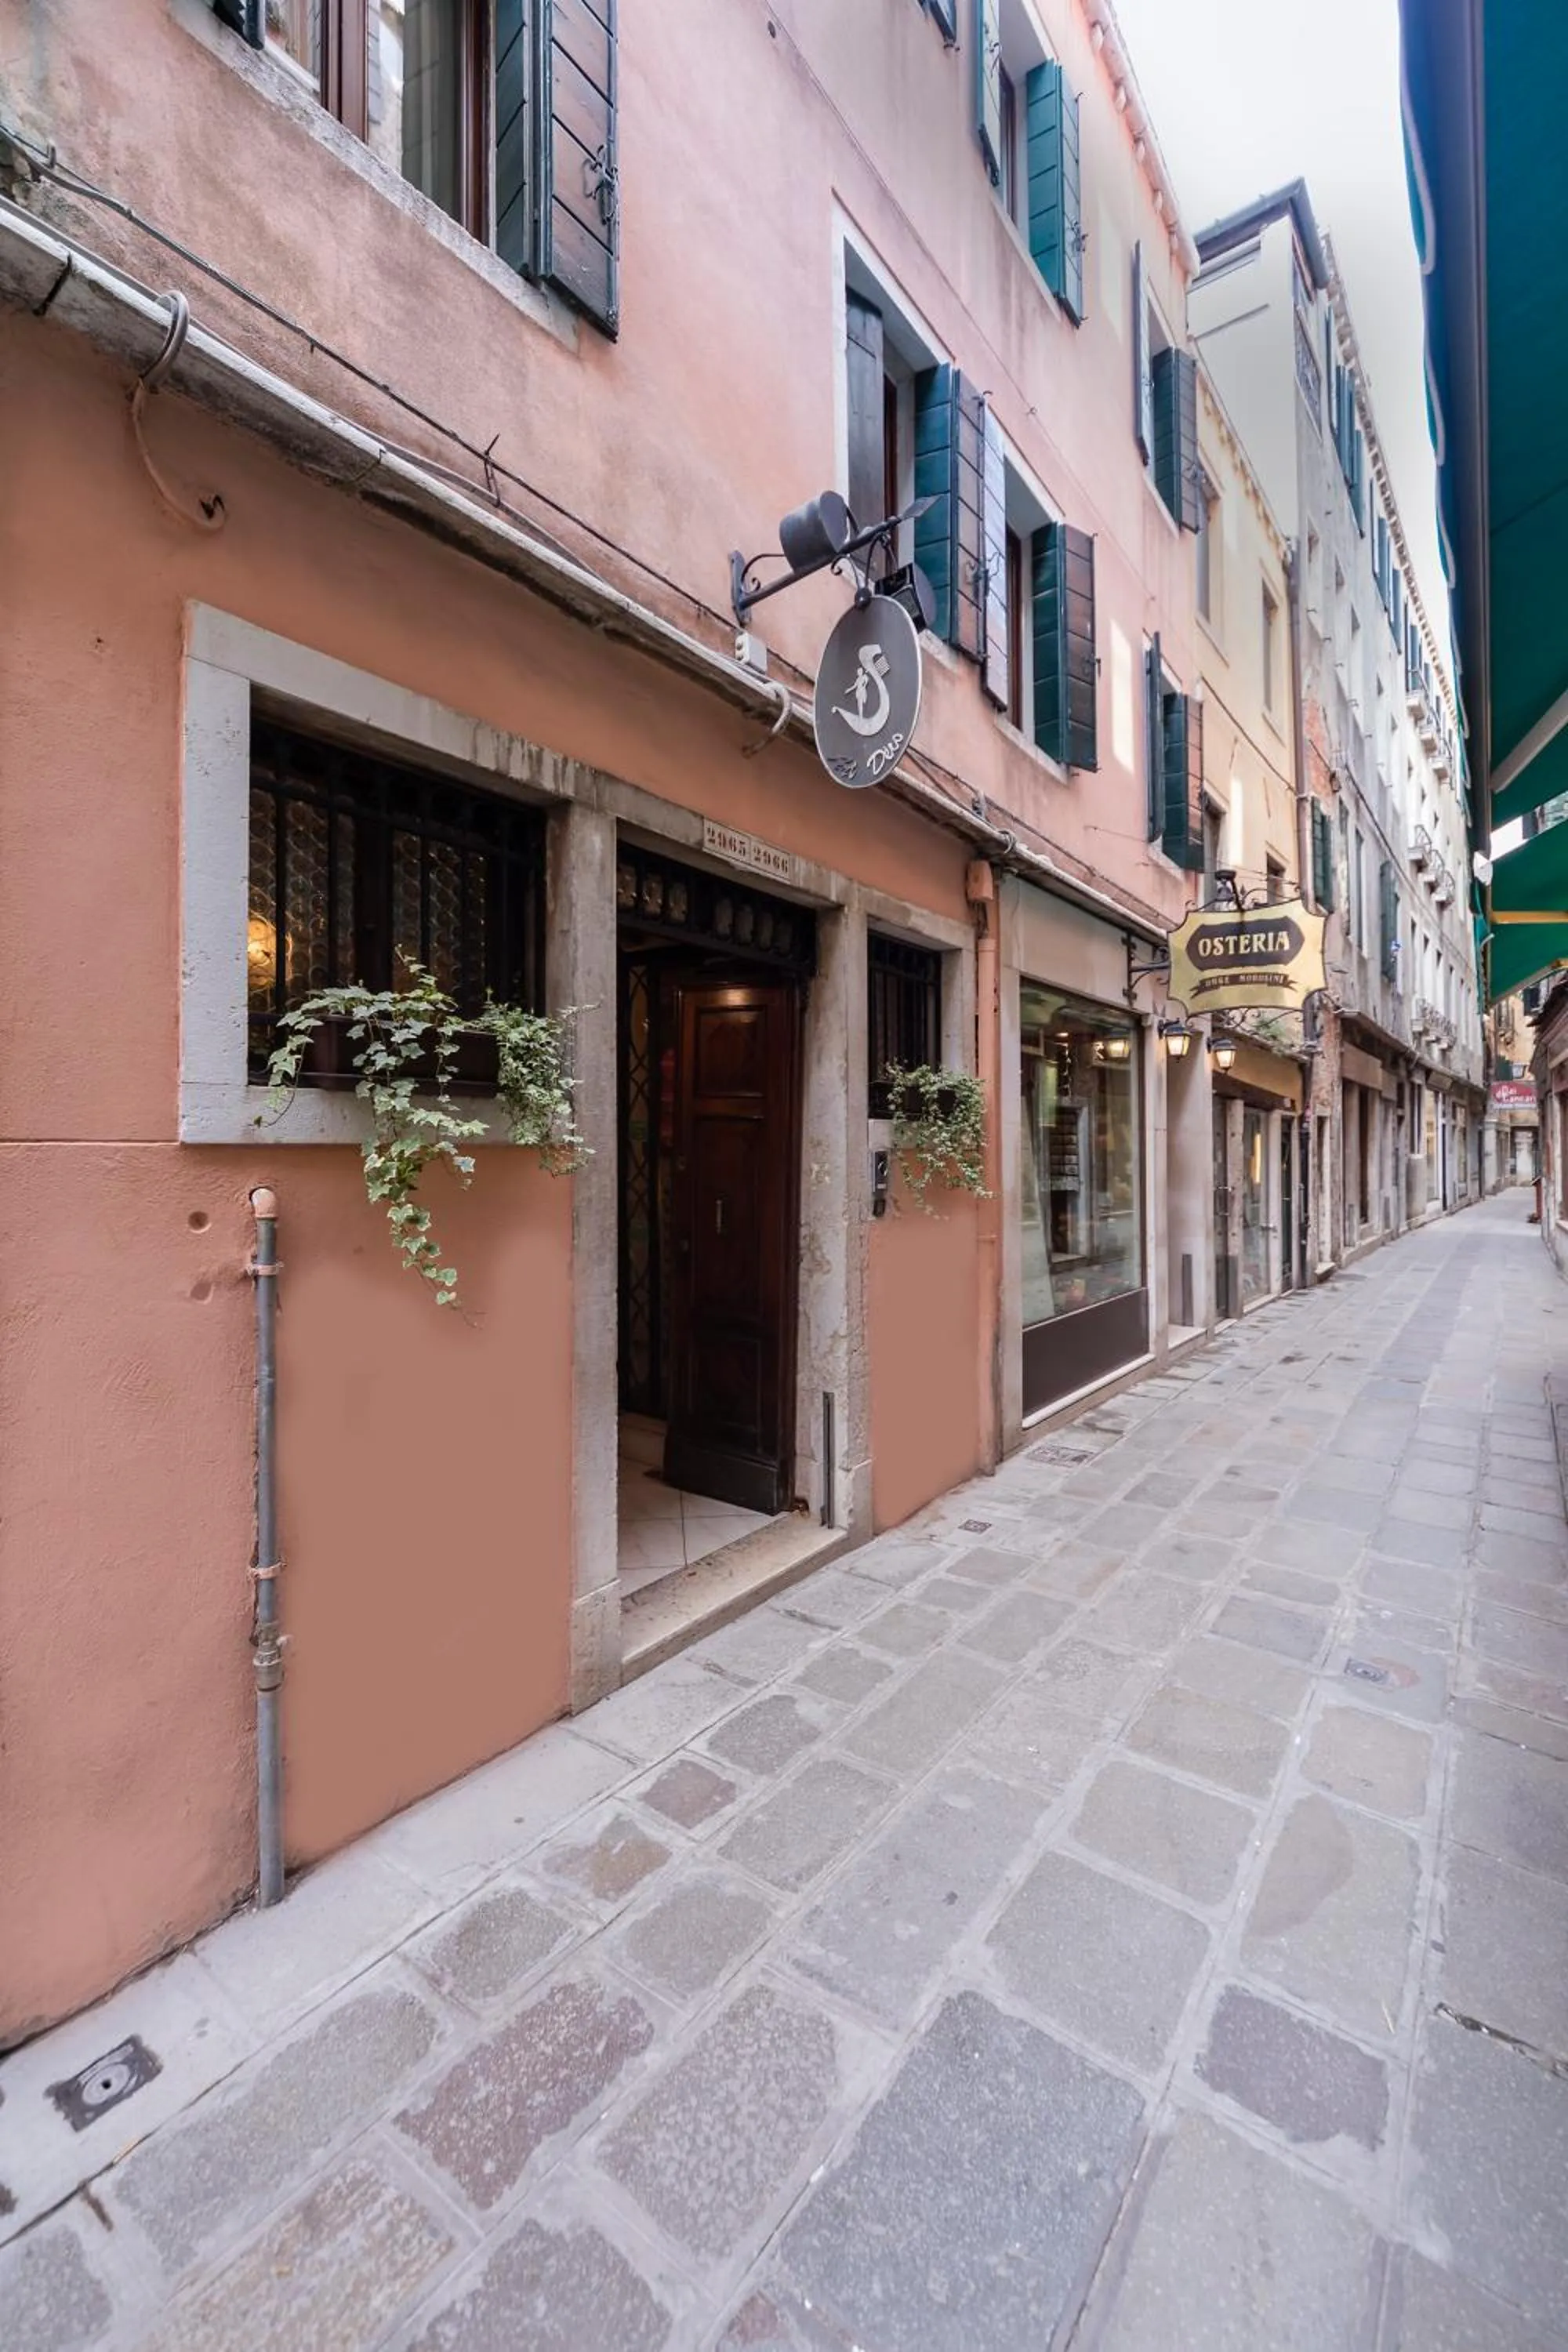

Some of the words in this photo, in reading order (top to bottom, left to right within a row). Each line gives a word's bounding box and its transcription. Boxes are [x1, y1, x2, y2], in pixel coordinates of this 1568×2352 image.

[706, 826, 746, 857] 2965
[753, 846, 789, 873] 2966
[1197, 931, 1290, 957] OSTERIA
